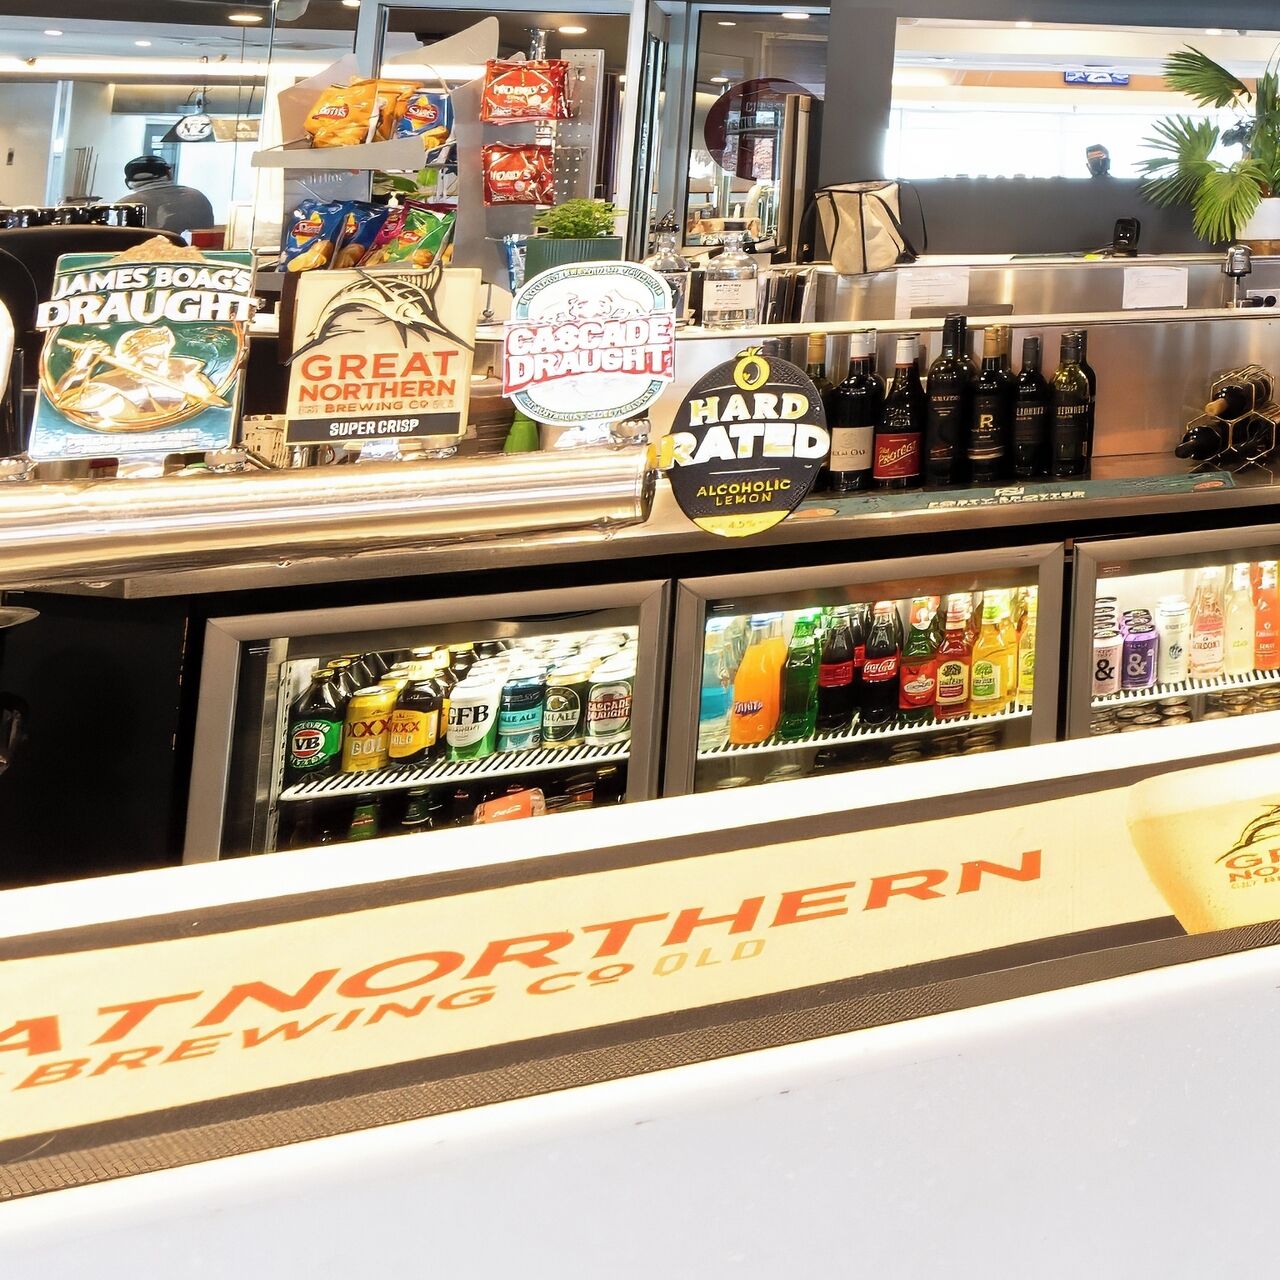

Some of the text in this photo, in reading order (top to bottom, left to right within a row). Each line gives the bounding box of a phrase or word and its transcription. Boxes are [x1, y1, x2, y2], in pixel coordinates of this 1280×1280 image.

[52, 266, 253, 301] JAMES BOAG'S
[35, 290, 258, 332] DRAUGHT
[507, 316, 673, 357] CASCADE
[300, 350, 459, 382] GREAT
[507, 346, 668, 388] DRAUGHT
[298, 379, 457, 403] NORTHERN
[324, 400, 404, 414] BREWING
[688, 392, 810, 427] HARD
[329, 419, 420, 437] SUPER CRISP
[658, 422, 831, 471] RATED
[696, 479, 792, 498] ALCOHOLIC
[714, 491, 773, 507] LEMON
[294, 736, 321, 751] VB
[190, 848, 1045, 1030] NORTHERN
[10, 986, 500, 1093] BREWING
[649, 939, 768, 978] QLD
